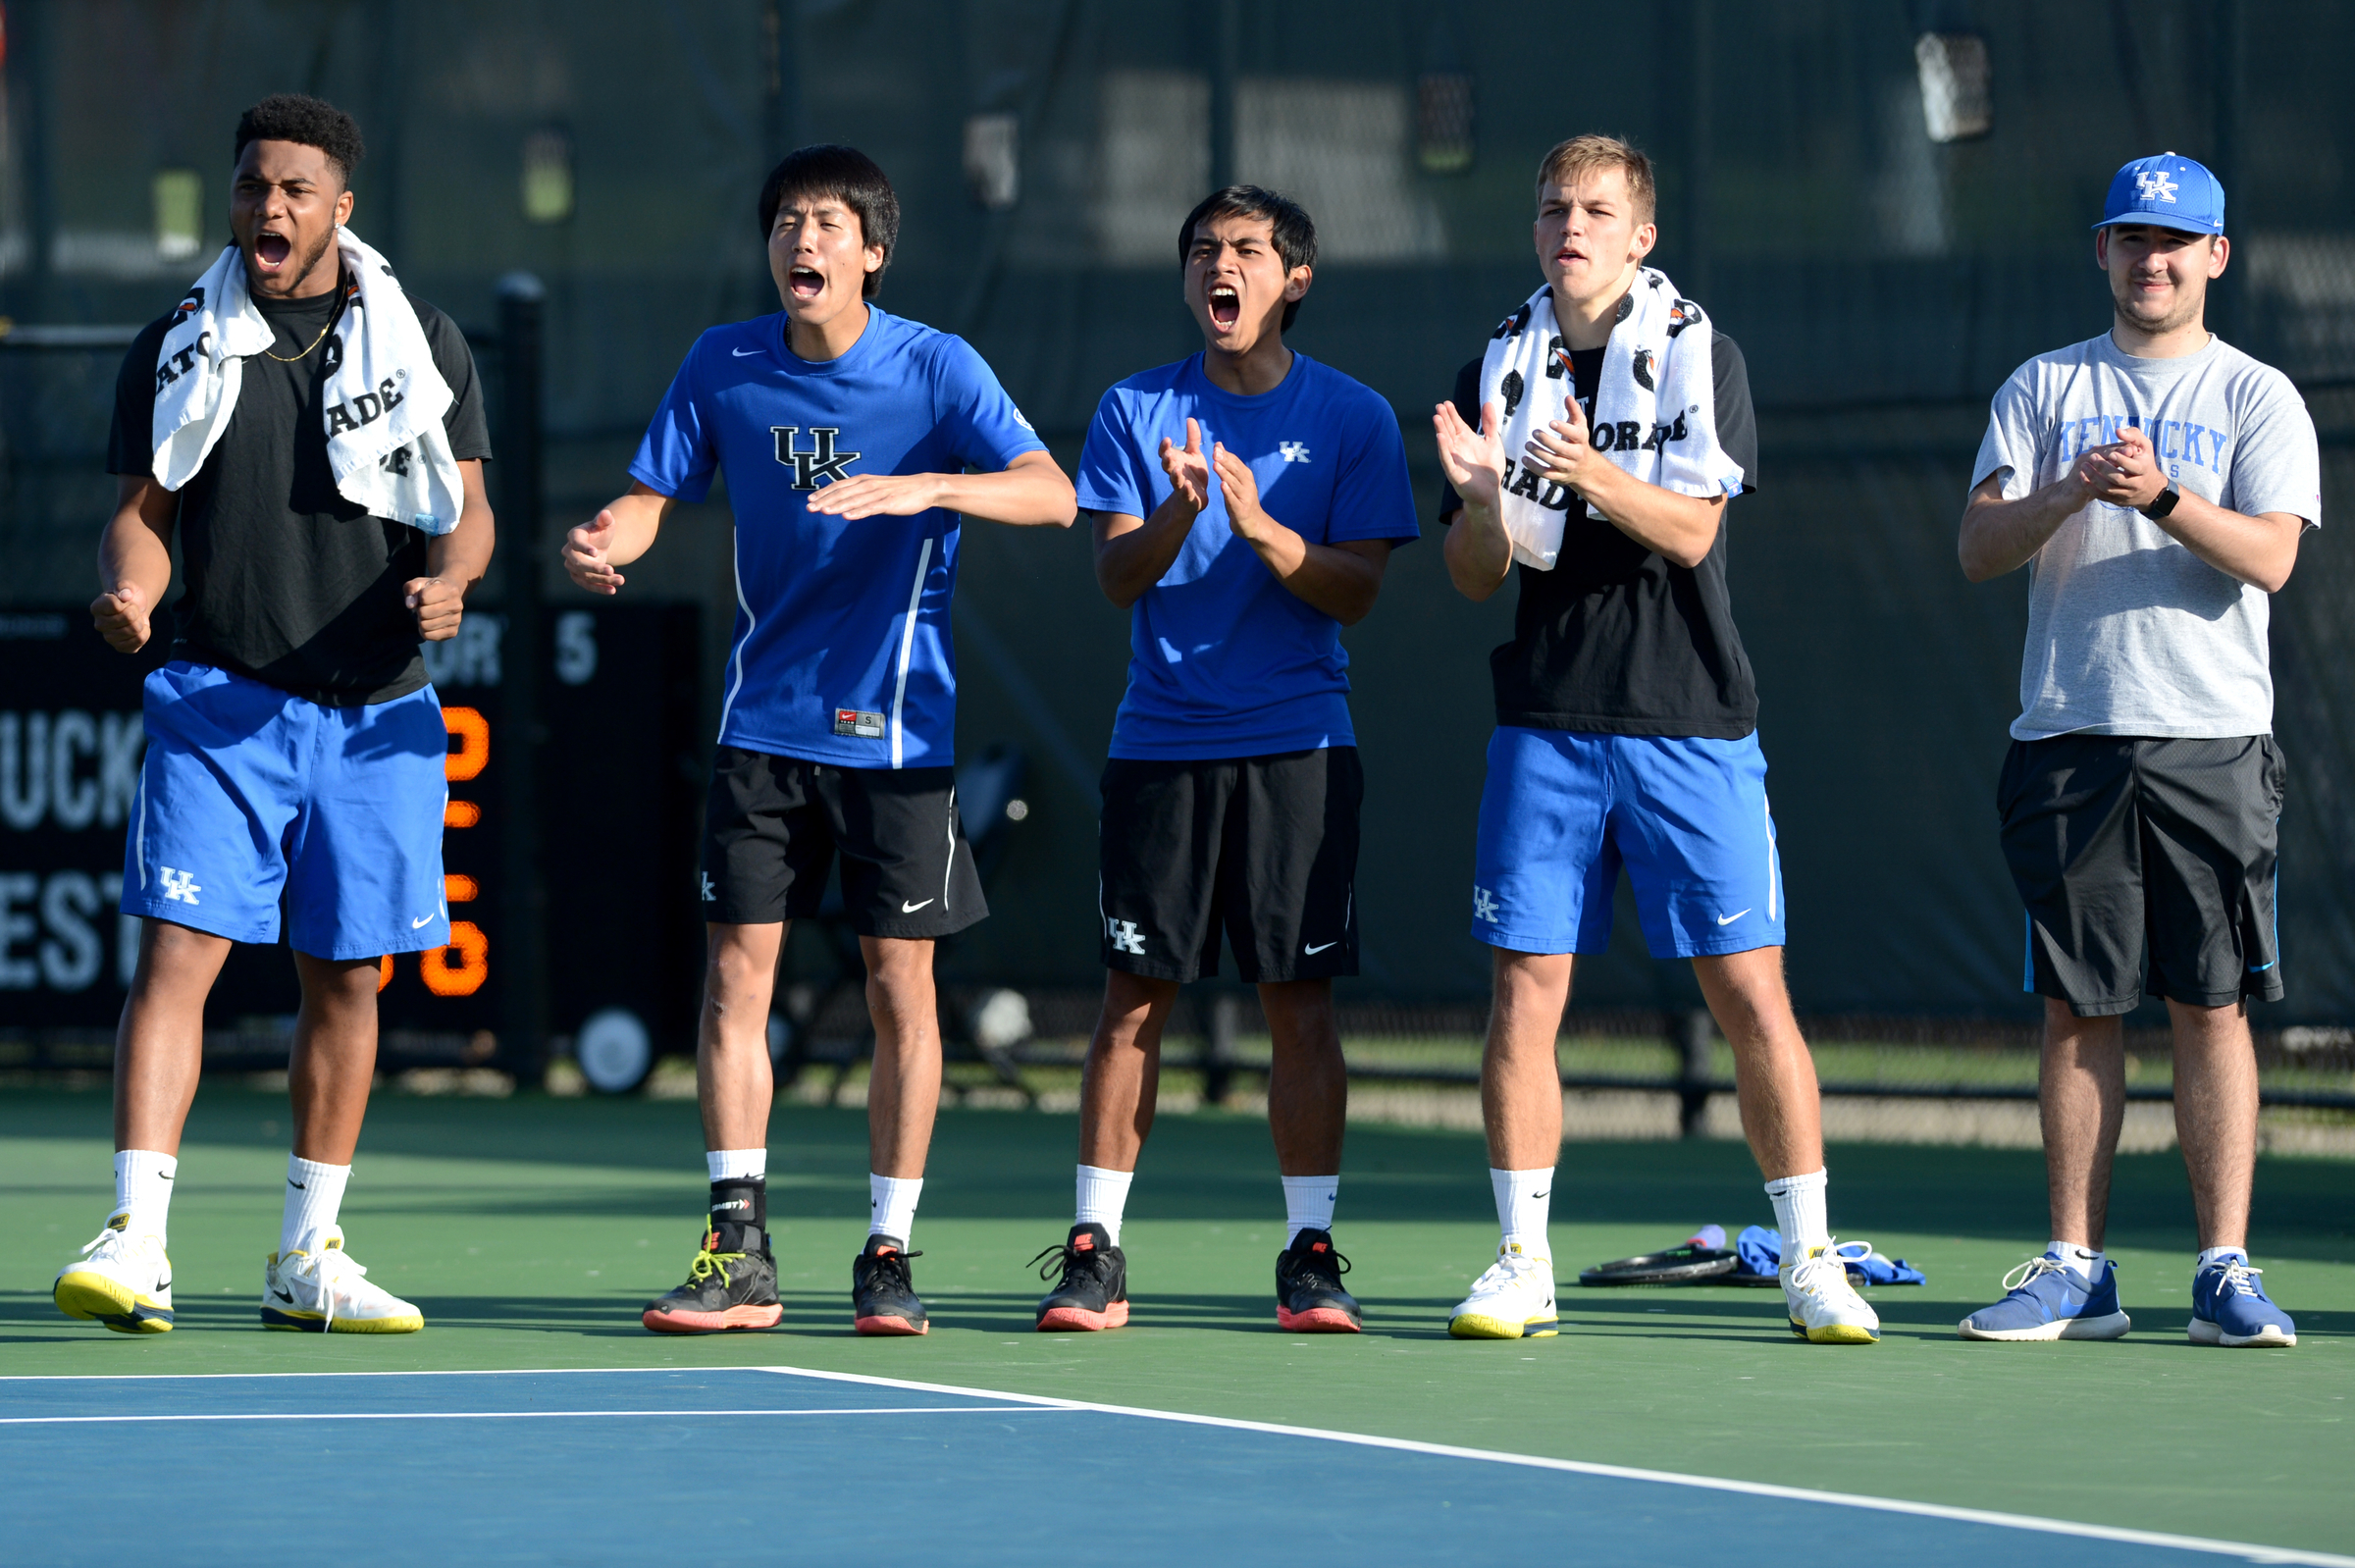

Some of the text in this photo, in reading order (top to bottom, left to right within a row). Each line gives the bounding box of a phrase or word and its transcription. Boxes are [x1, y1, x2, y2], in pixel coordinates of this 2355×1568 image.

[2135, 171, 2178, 203] UK
[770, 426, 862, 491] UK
[1279, 441, 1310, 463] UK
[2061, 414, 2227, 475] KENUCKY
[555, 609, 600, 686] 5
[160, 865, 201, 906] UK
[1474, 884, 1499, 923] UK
[1108, 916, 1146, 955] UK
